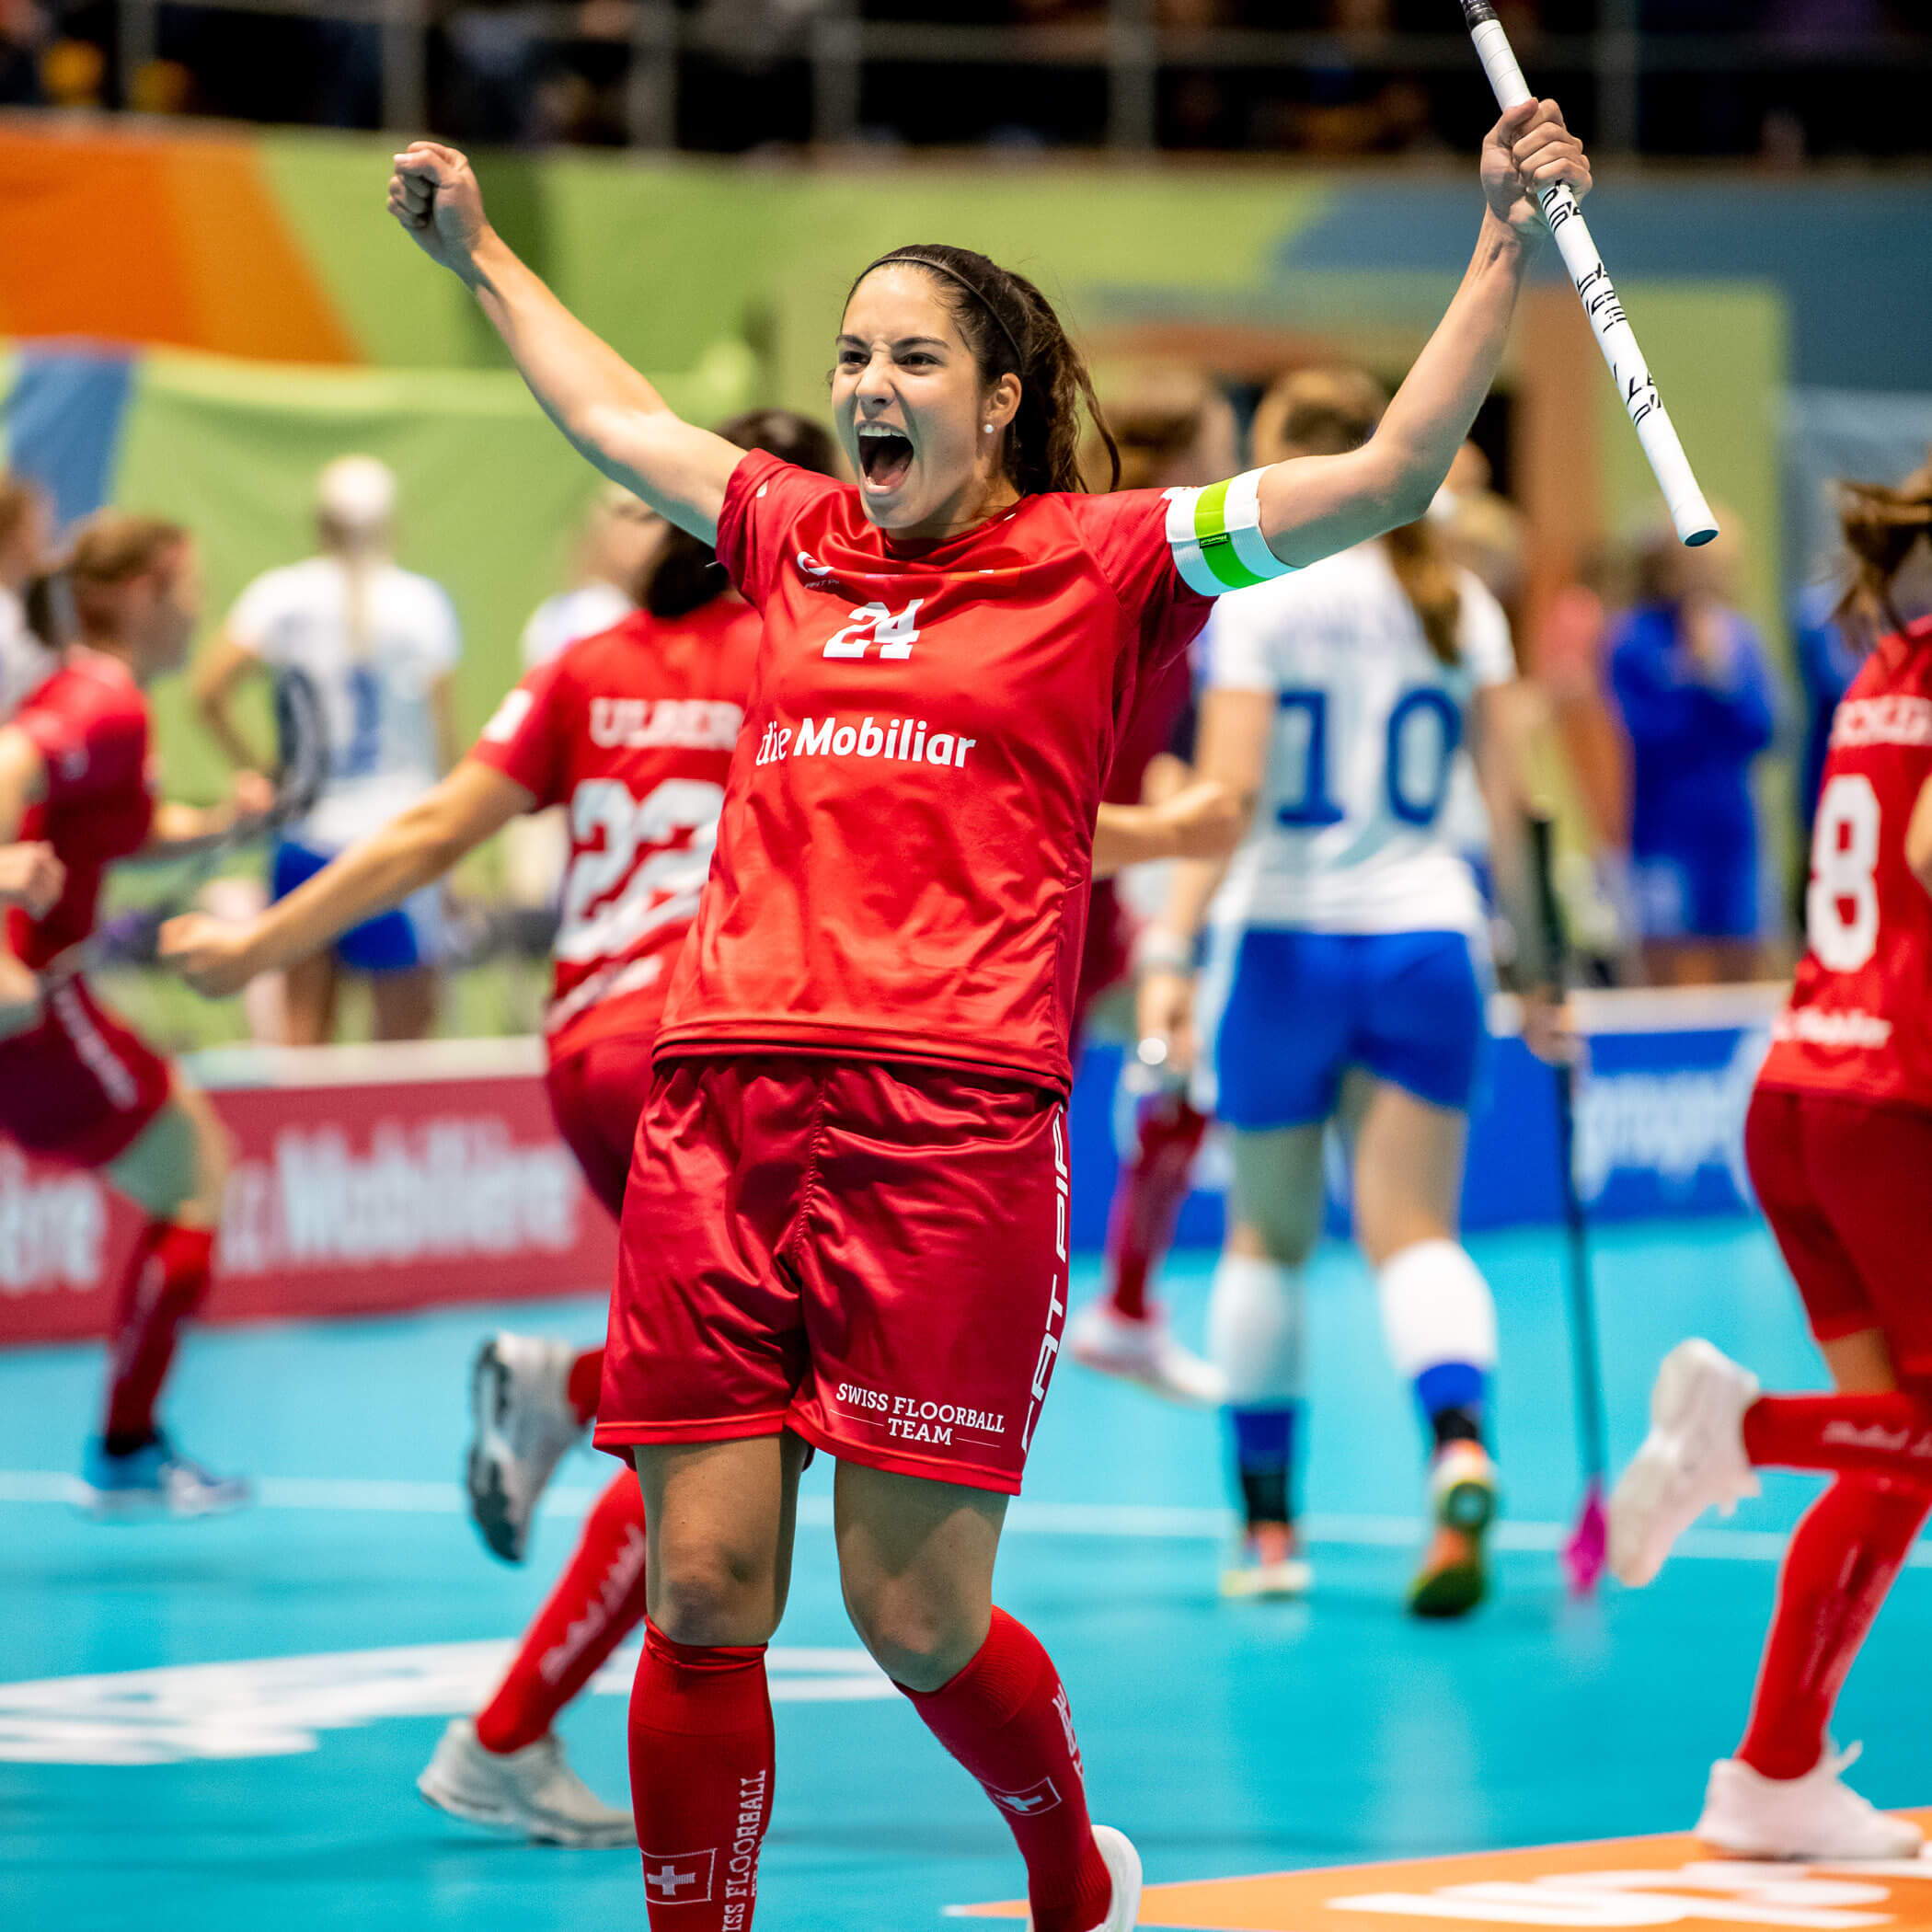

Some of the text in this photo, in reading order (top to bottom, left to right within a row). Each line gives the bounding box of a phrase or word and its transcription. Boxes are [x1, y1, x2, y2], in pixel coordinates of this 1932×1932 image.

[822, 599, 924, 660] 24
[755, 717, 977, 767] die Mobiliar
[1277, 690, 1463, 825] 10
[556, 778, 734, 962] 22
[1807, 775, 1880, 972] 8
[1052, 1104, 1068, 1263] PIP
[835, 1383, 1006, 1433] SWISS FLOORBALL
[887, 1417, 953, 1446] TEAM
[725, 1769, 766, 1898] FLOORBALL
